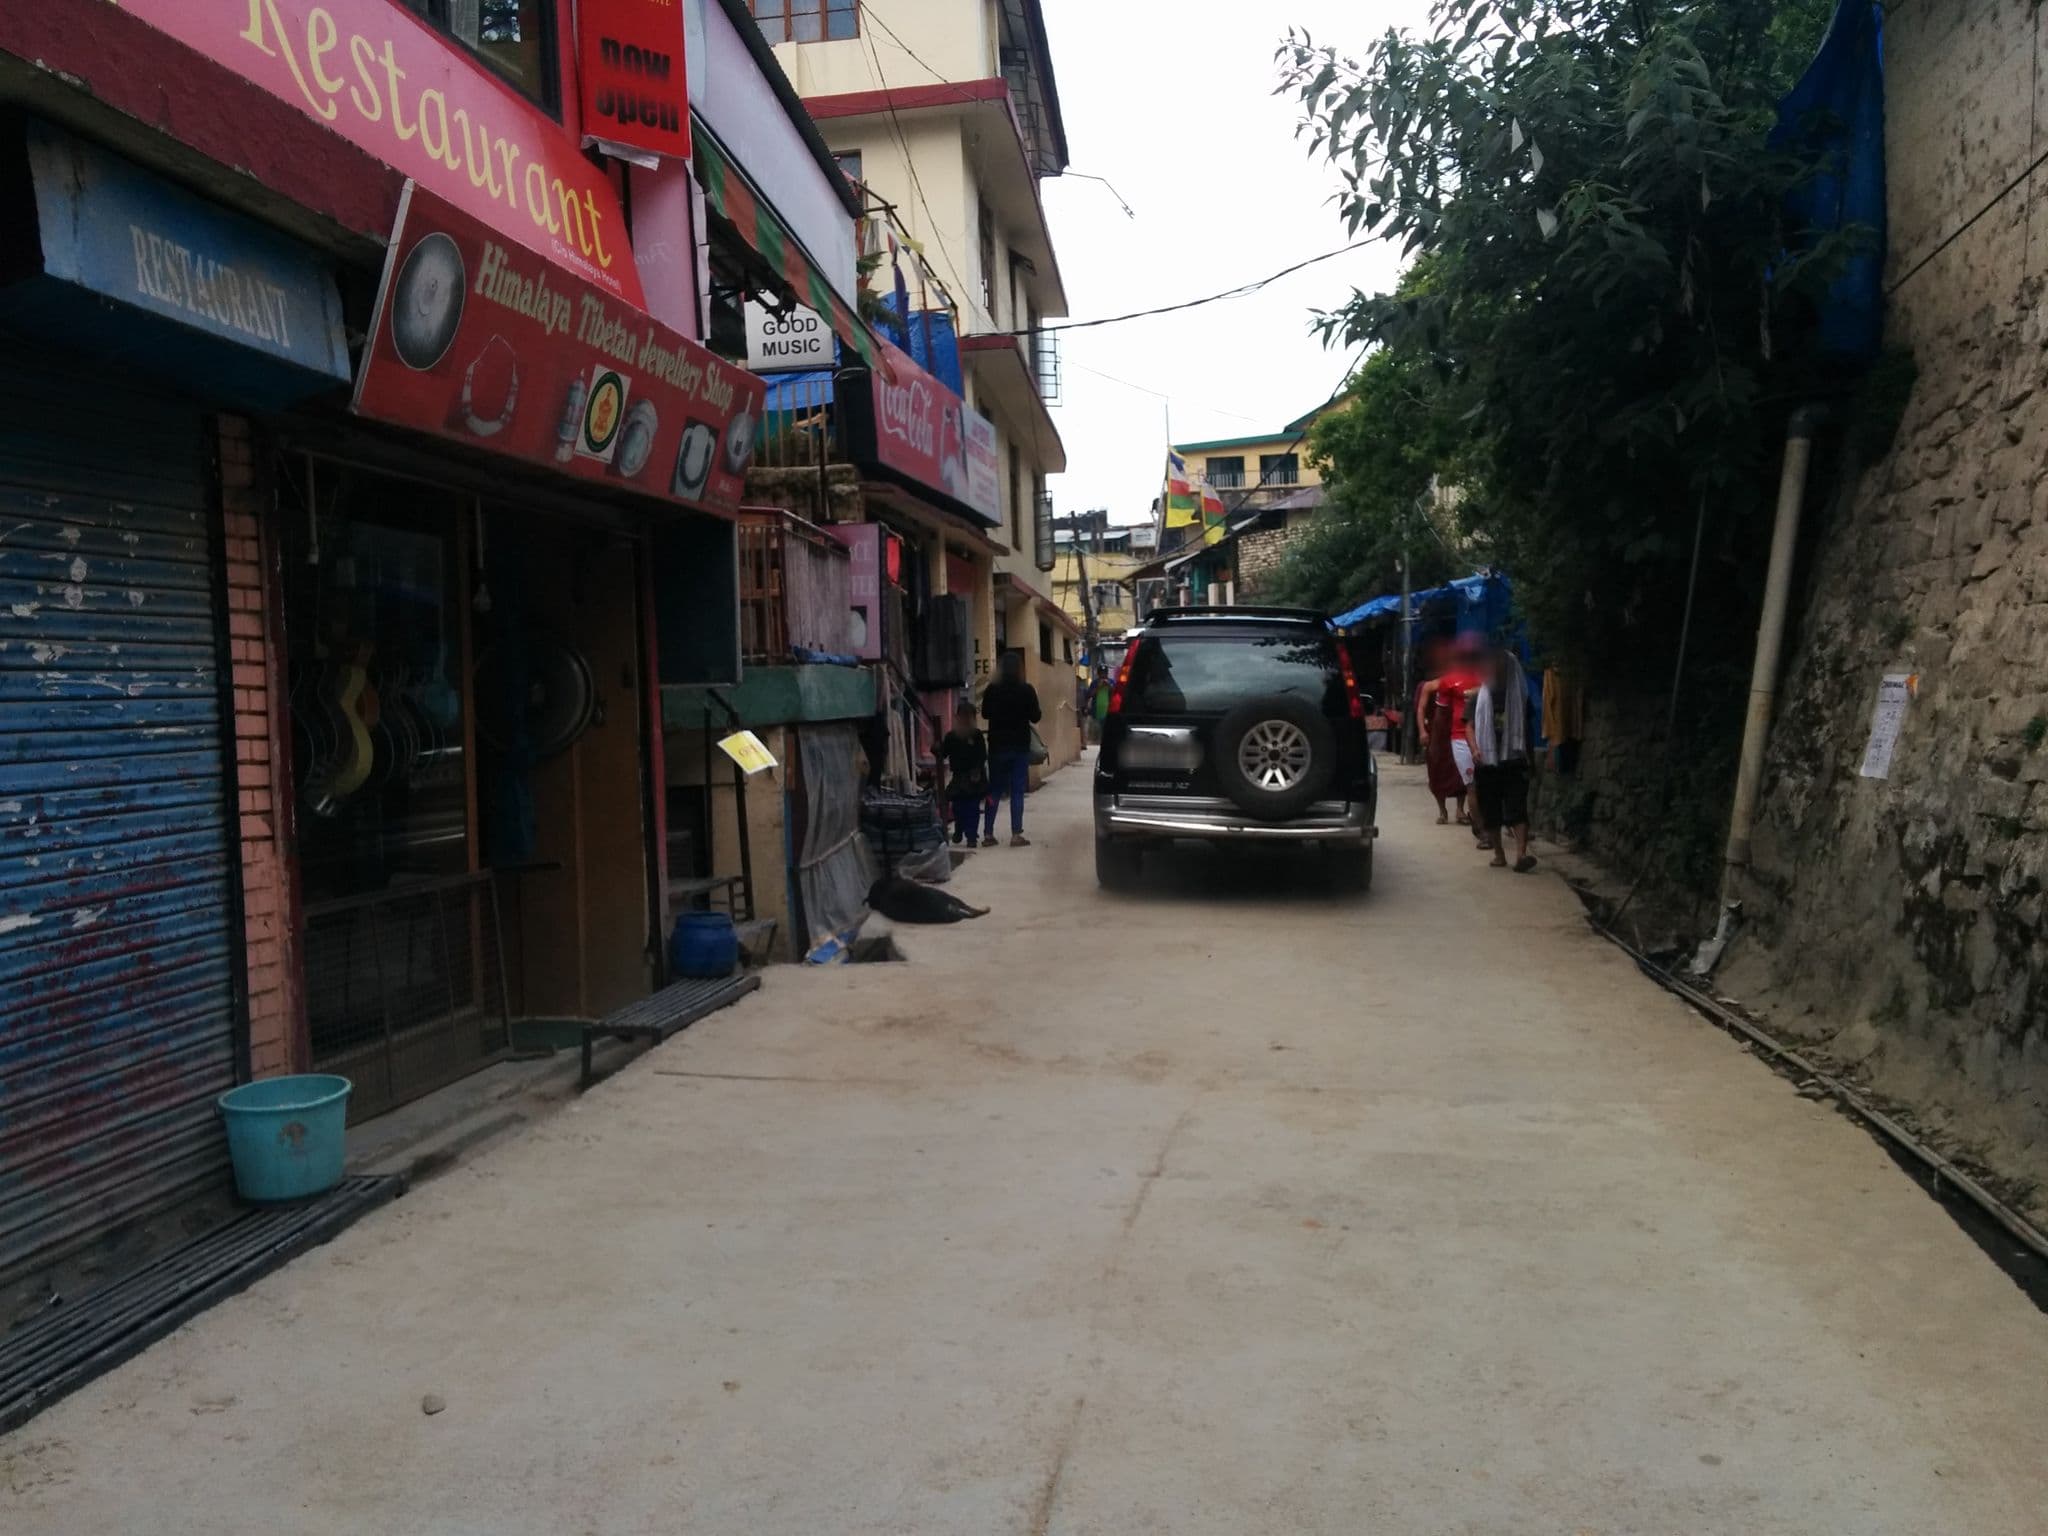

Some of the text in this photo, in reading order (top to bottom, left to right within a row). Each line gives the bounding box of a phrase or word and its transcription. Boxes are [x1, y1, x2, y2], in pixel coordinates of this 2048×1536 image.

[129, 224, 290, 348] RESTAURANT
[475, 241, 734, 415] Himalaya Tibetan Jewellery Shop
[762, 317, 818, 336] GOOD
[762, 337, 821, 357] MUSIC
[974, 658, 990, 675] FE
